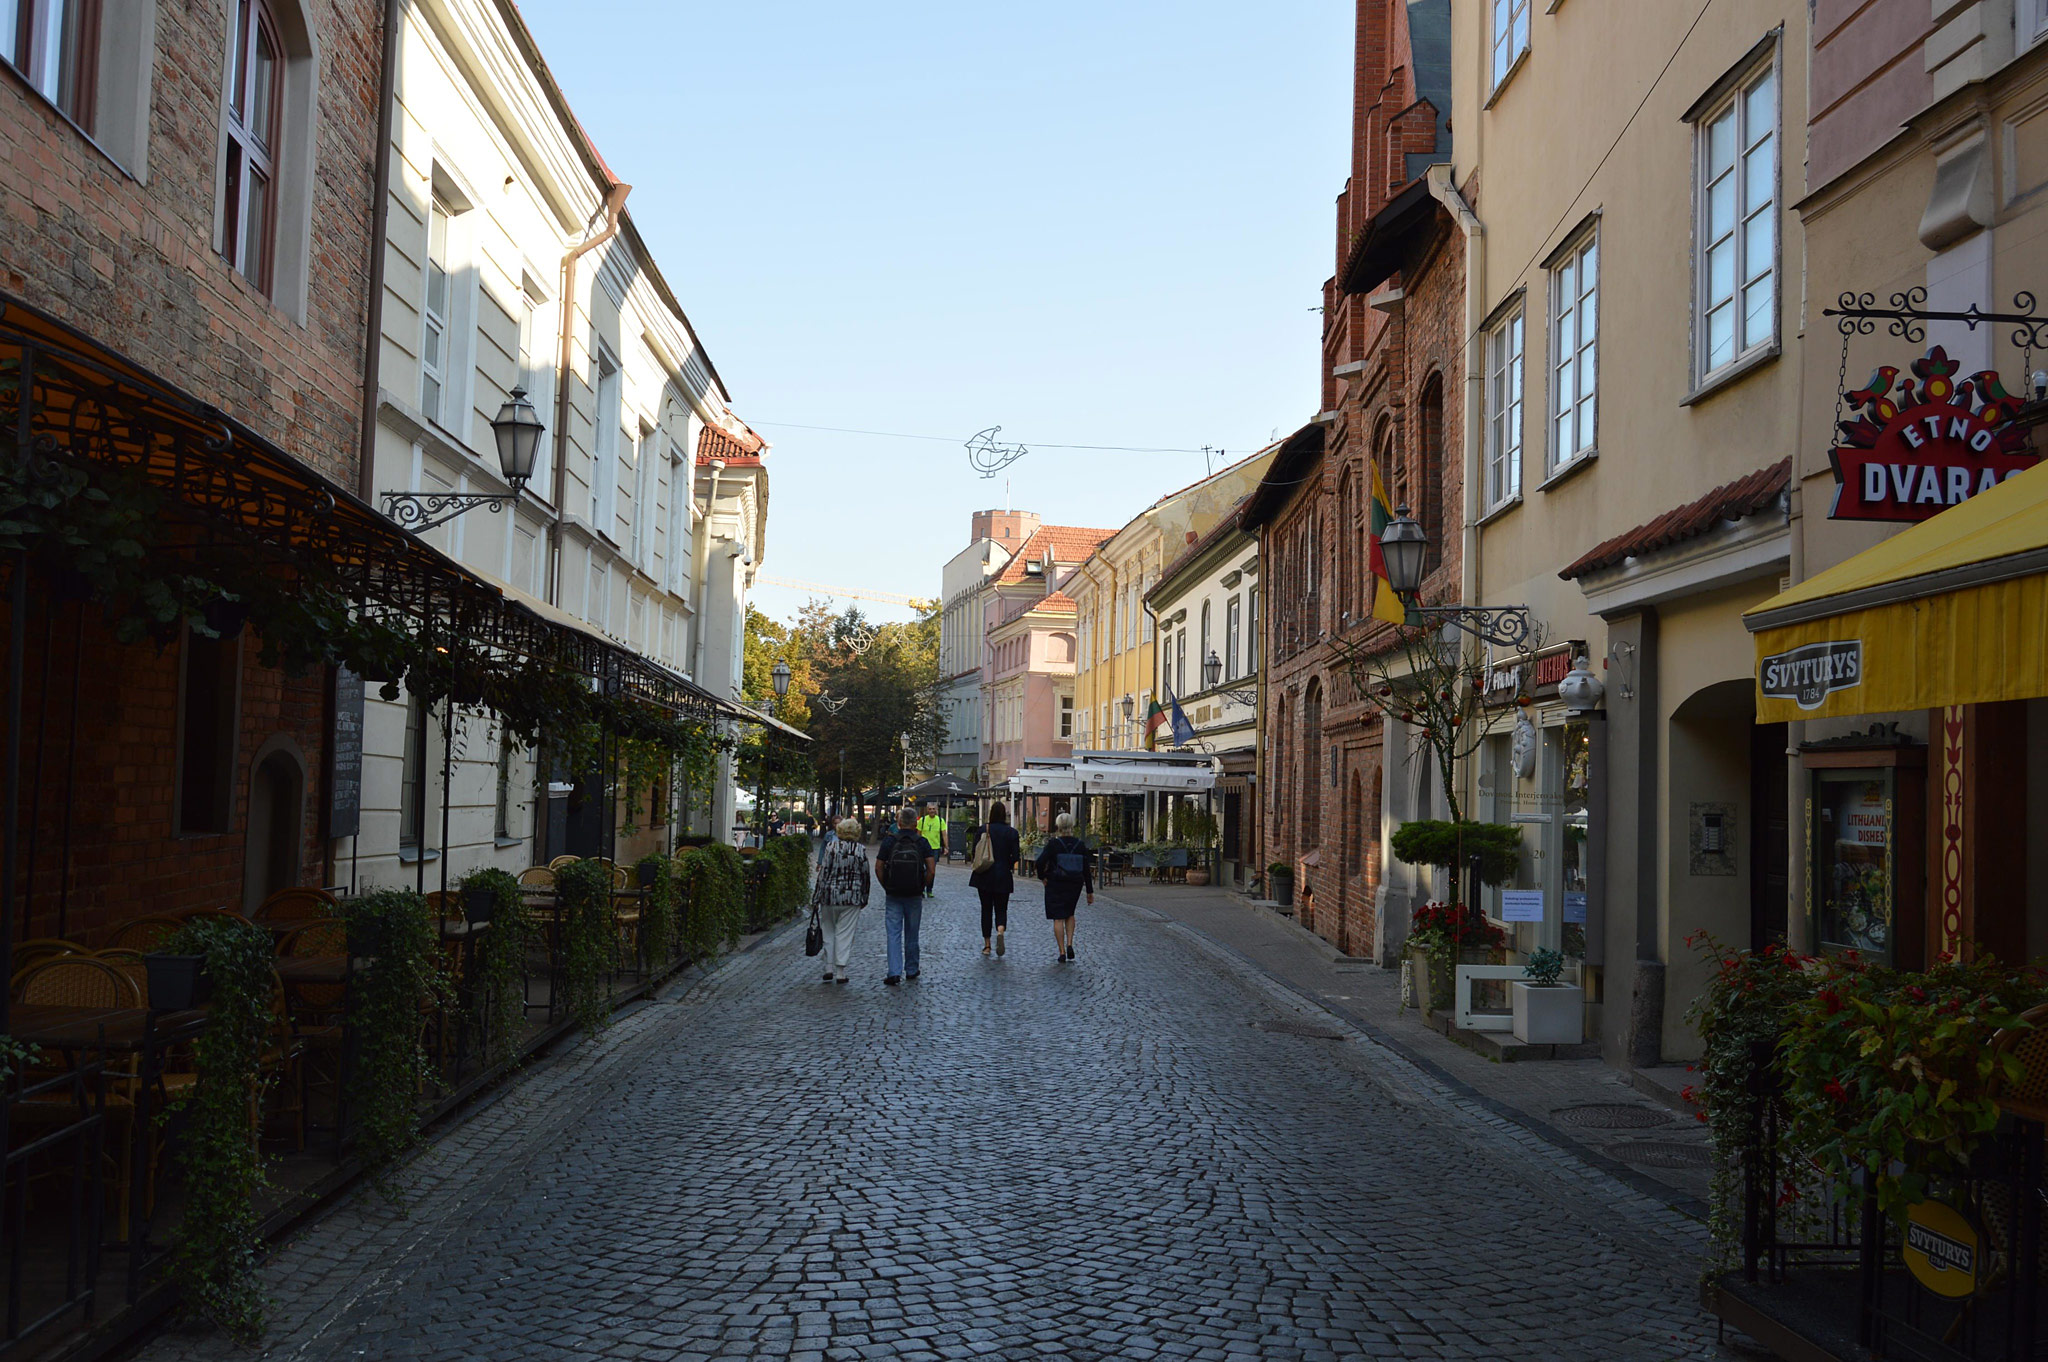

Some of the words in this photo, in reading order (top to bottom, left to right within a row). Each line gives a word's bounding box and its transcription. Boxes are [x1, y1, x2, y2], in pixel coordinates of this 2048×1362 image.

[1902, 415, 1992, 452] ETNO
[1765, 650, 1857, 689] ŠVYTURYS
[1803, 687, 1820, 700] 1784
[1858, 830, 1884, 842] DISHES
